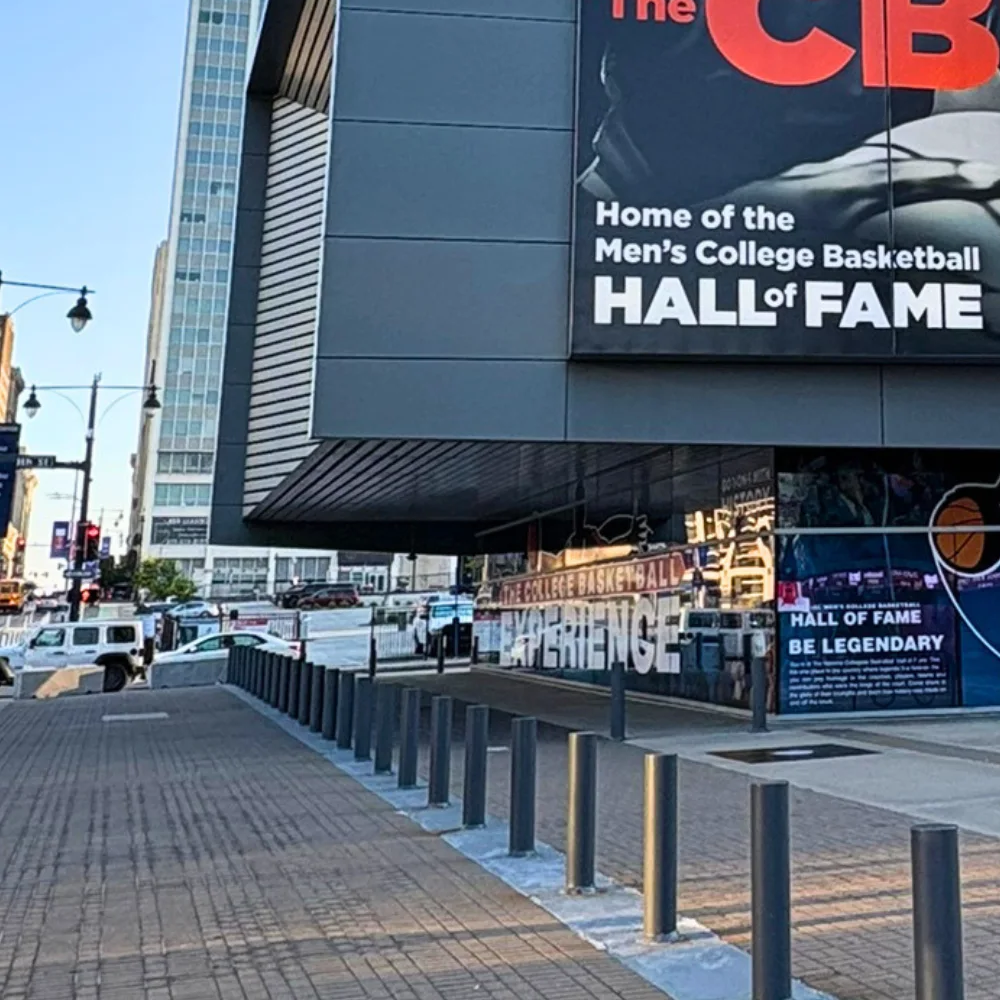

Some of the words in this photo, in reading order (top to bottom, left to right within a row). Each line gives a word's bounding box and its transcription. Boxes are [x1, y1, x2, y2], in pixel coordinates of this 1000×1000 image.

[595, 201, 692, 228] Home
[701, 204, 735, 230] of
[742, 205, 795, 231] the
[595, 237, 687, 264] Men's
[695, 240, 814, 271] College
[823, 243, 981, 272] Basketball
[594, 275, 777, 326] HALL
[763, 282, 798, 308] of
[804, 279, 984, 330] FAME
[503, 583, 522, 605] THE
[524, 571, 575, 601] COLLEGE
[578, 553, 681, 595] BASKETBALL
[500, 594, 681, 675] EXPERIENCE
[790, 611, 839, 628] HALL
[843, 611, 868, 626] OF
[873, 609, 922, 625] FAME
[788, 638, 816, 655] BE
[822, 635, 945, 655] LEGENDARY
